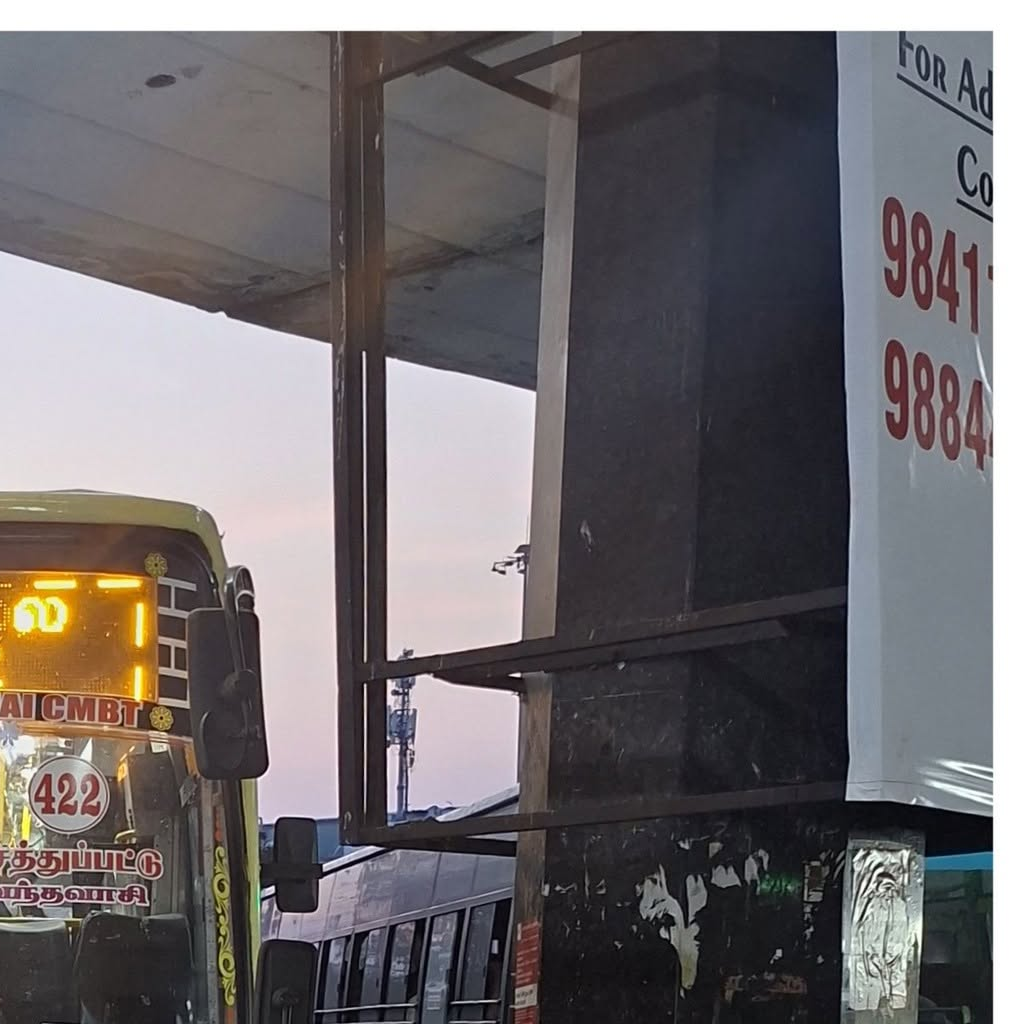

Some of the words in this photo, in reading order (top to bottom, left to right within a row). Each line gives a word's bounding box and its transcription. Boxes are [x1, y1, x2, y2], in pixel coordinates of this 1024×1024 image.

[882, 196, 993, 335] 9841
[883, 339, 993, 471] 9884
[41, 694, 143, 727] CMBT
[34, 773, 101, 816] 422
